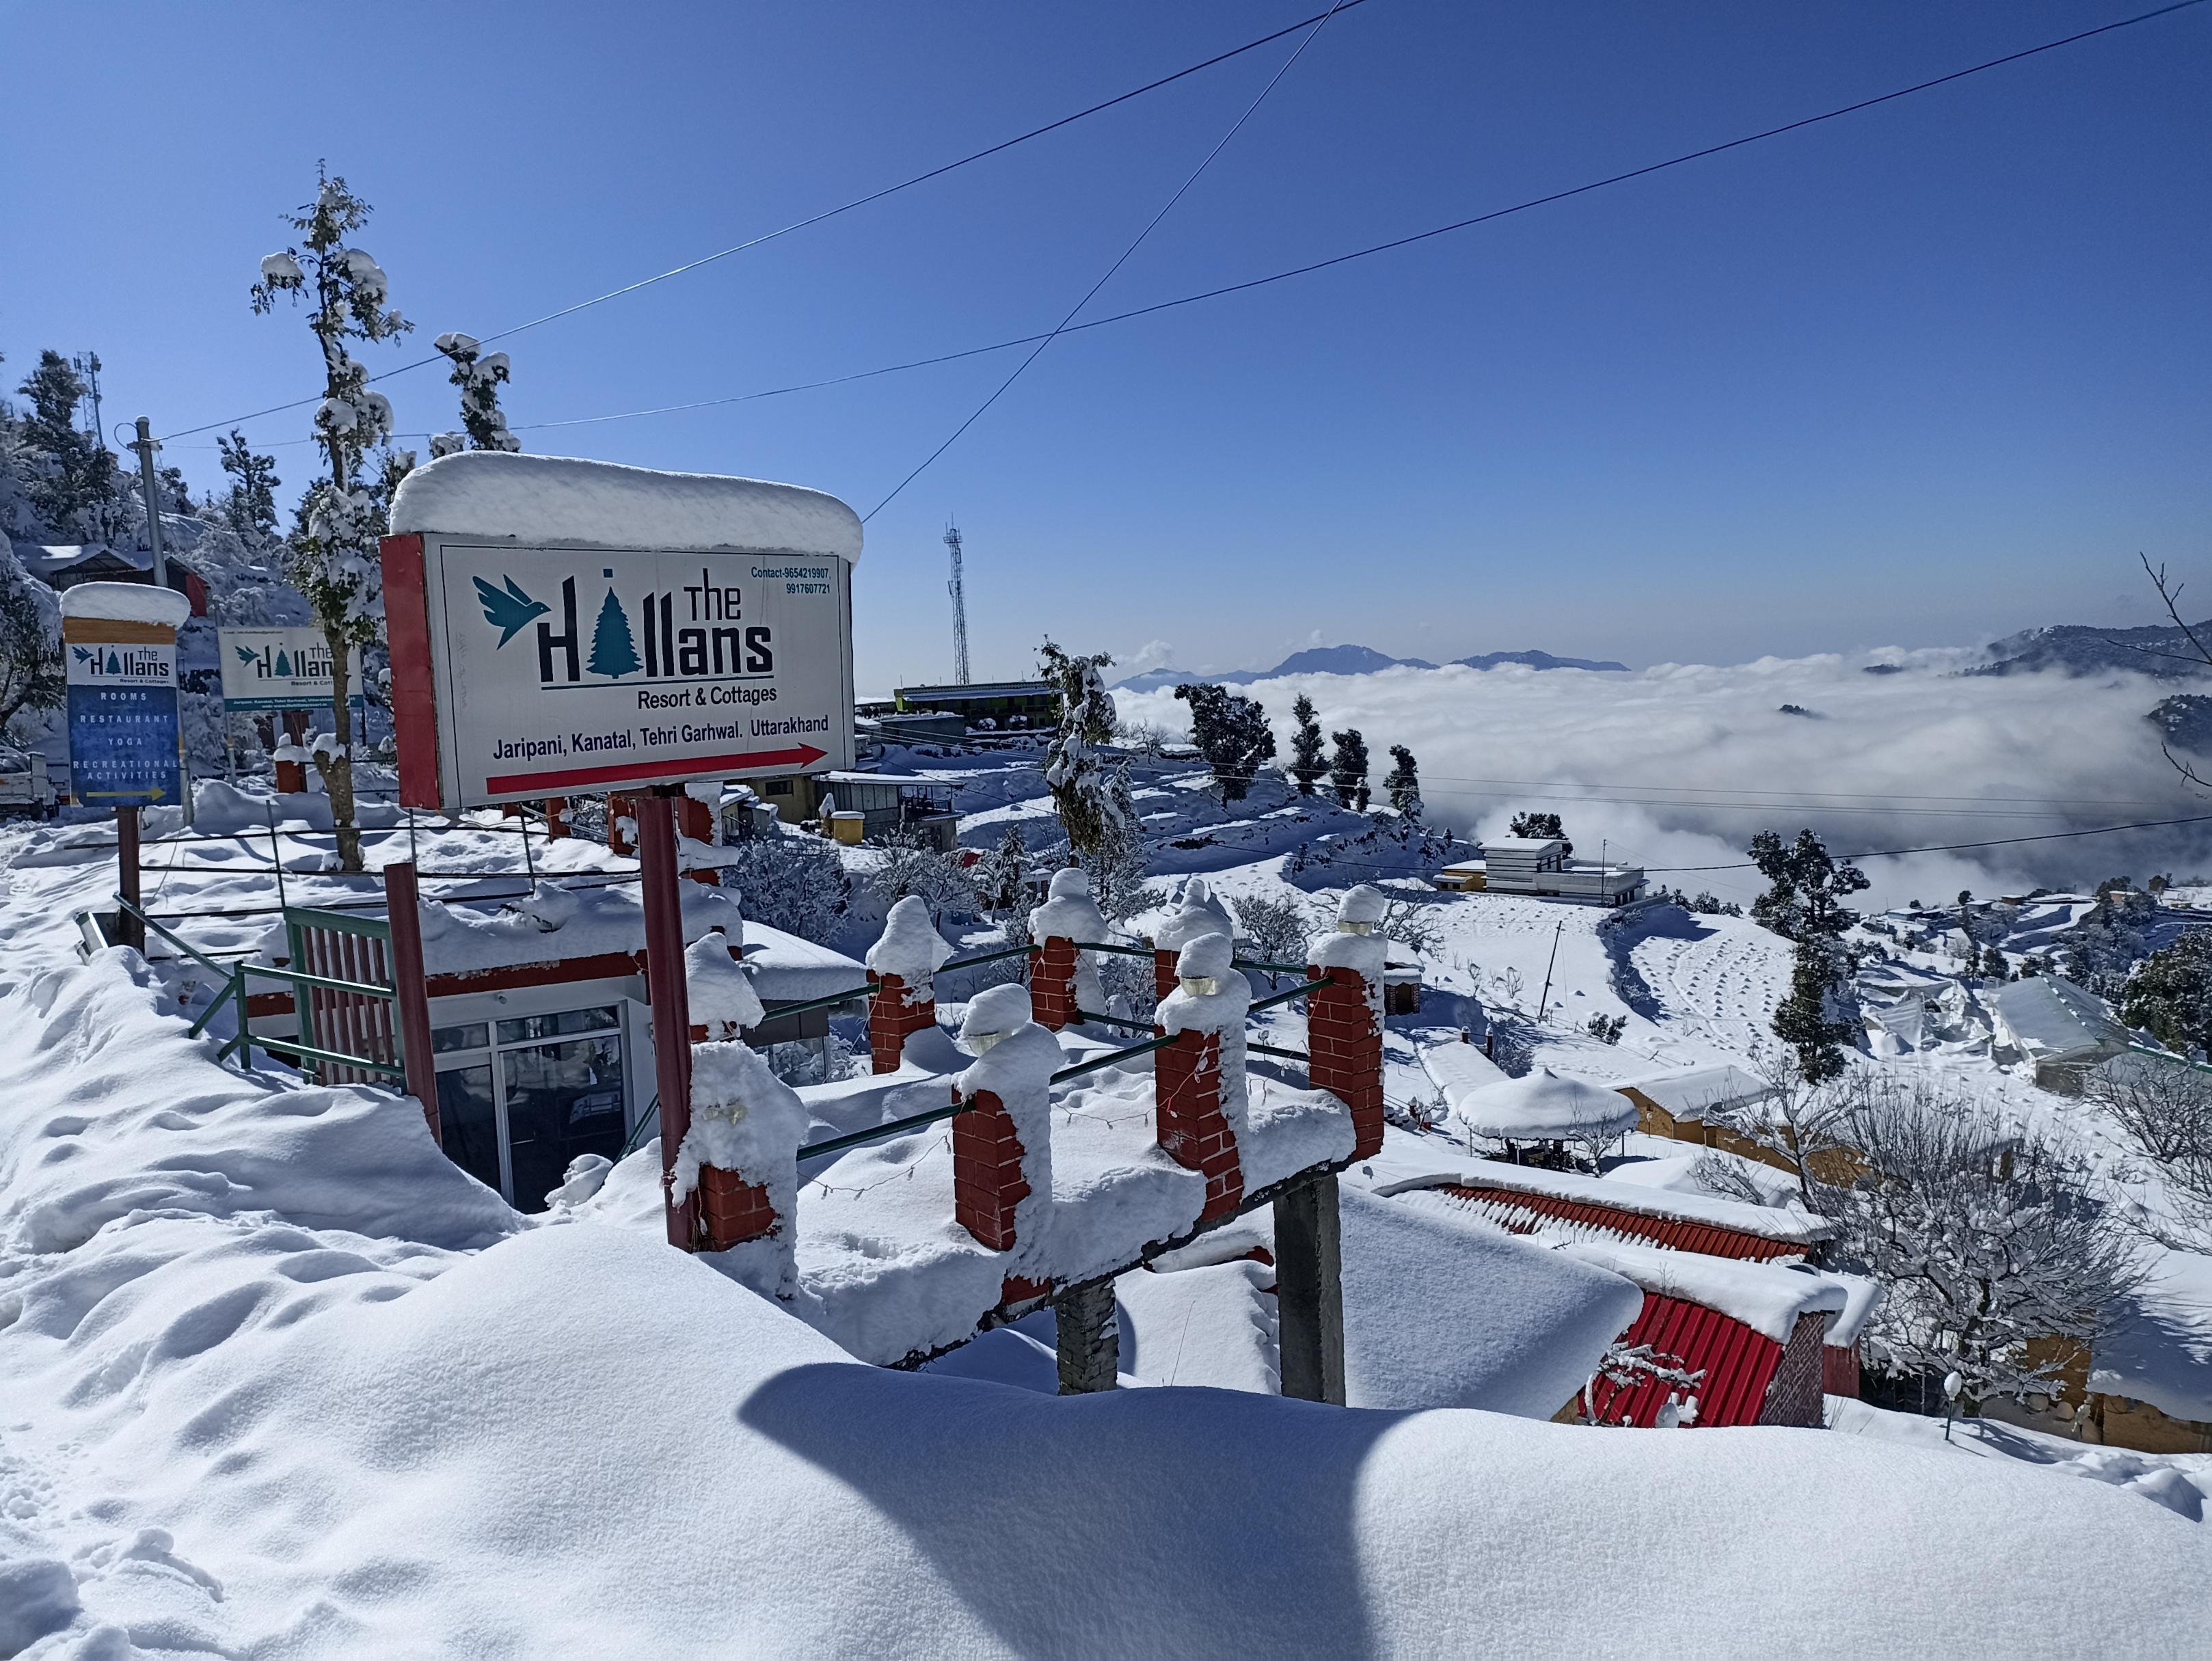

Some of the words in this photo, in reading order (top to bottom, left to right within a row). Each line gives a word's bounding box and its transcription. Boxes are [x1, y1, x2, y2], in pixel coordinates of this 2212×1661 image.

[786, 583, 831, 594] 9917607721
[684, 568, 741, 621] The
[138, 646, 158, 661] The
[257, 643, 333, 678] Hillan
[100, 692, 147, 701] ROOMS
[638, 689, 690, 710] Resort
[695, 687, 707, 706] &
[710, 686, 777, 706] Cottages
[80, 715, 169, 723] RESTAURANT
[108, 738, 142, 746] YOGA
[493, 735, 567, 761] Jaripani,
[571, 729, 636, 753] Kanatal,
[640, 725, 677, 746] Tehri
[681, 721, 743, 743] Garhwal.
[751, 714, 828, 737] Uttarakhand
[73, 760, 178, 769] RECREATIONAL
[87, 771, 167, 779] ACTIVITIES
